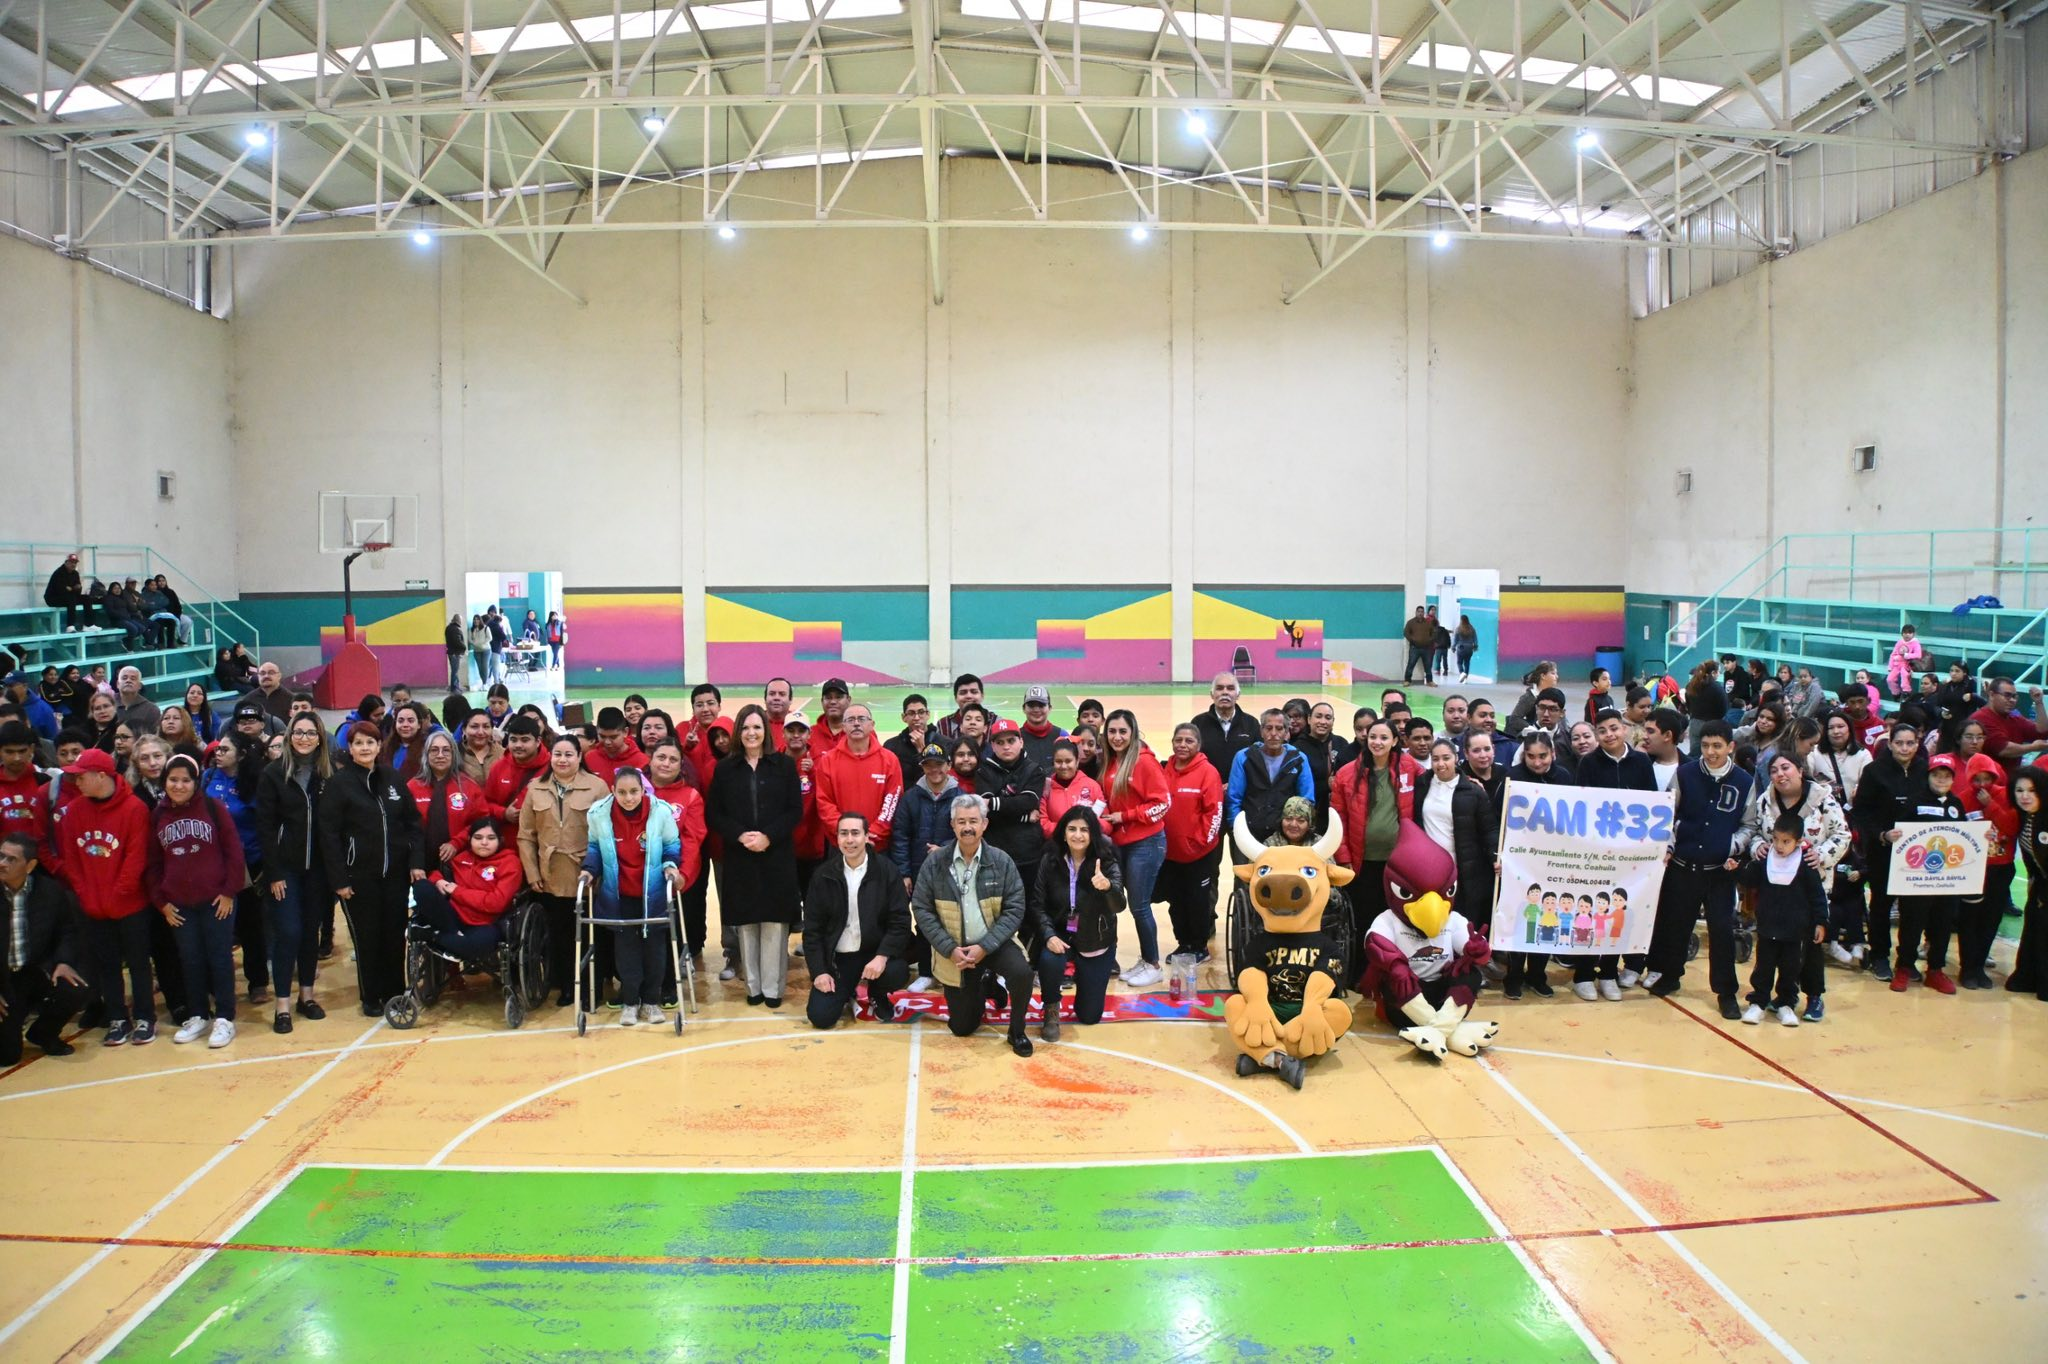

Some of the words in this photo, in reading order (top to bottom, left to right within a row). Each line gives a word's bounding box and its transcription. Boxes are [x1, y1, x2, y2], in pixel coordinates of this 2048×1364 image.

[1716, 783, 1740, 813] D
[1507, 795, 1586, 836] CAM
[1594, 800, 1673, 841] #32
[157, 818, 213, 848] LONDON
[1895, 834, 1918, 855] CENTRO
[1509, 846, 1527, 854] Calle
[1529, 847, 1582, 859] Ayuntamiento
[1584, 863, 1616, 872] Coahuila
